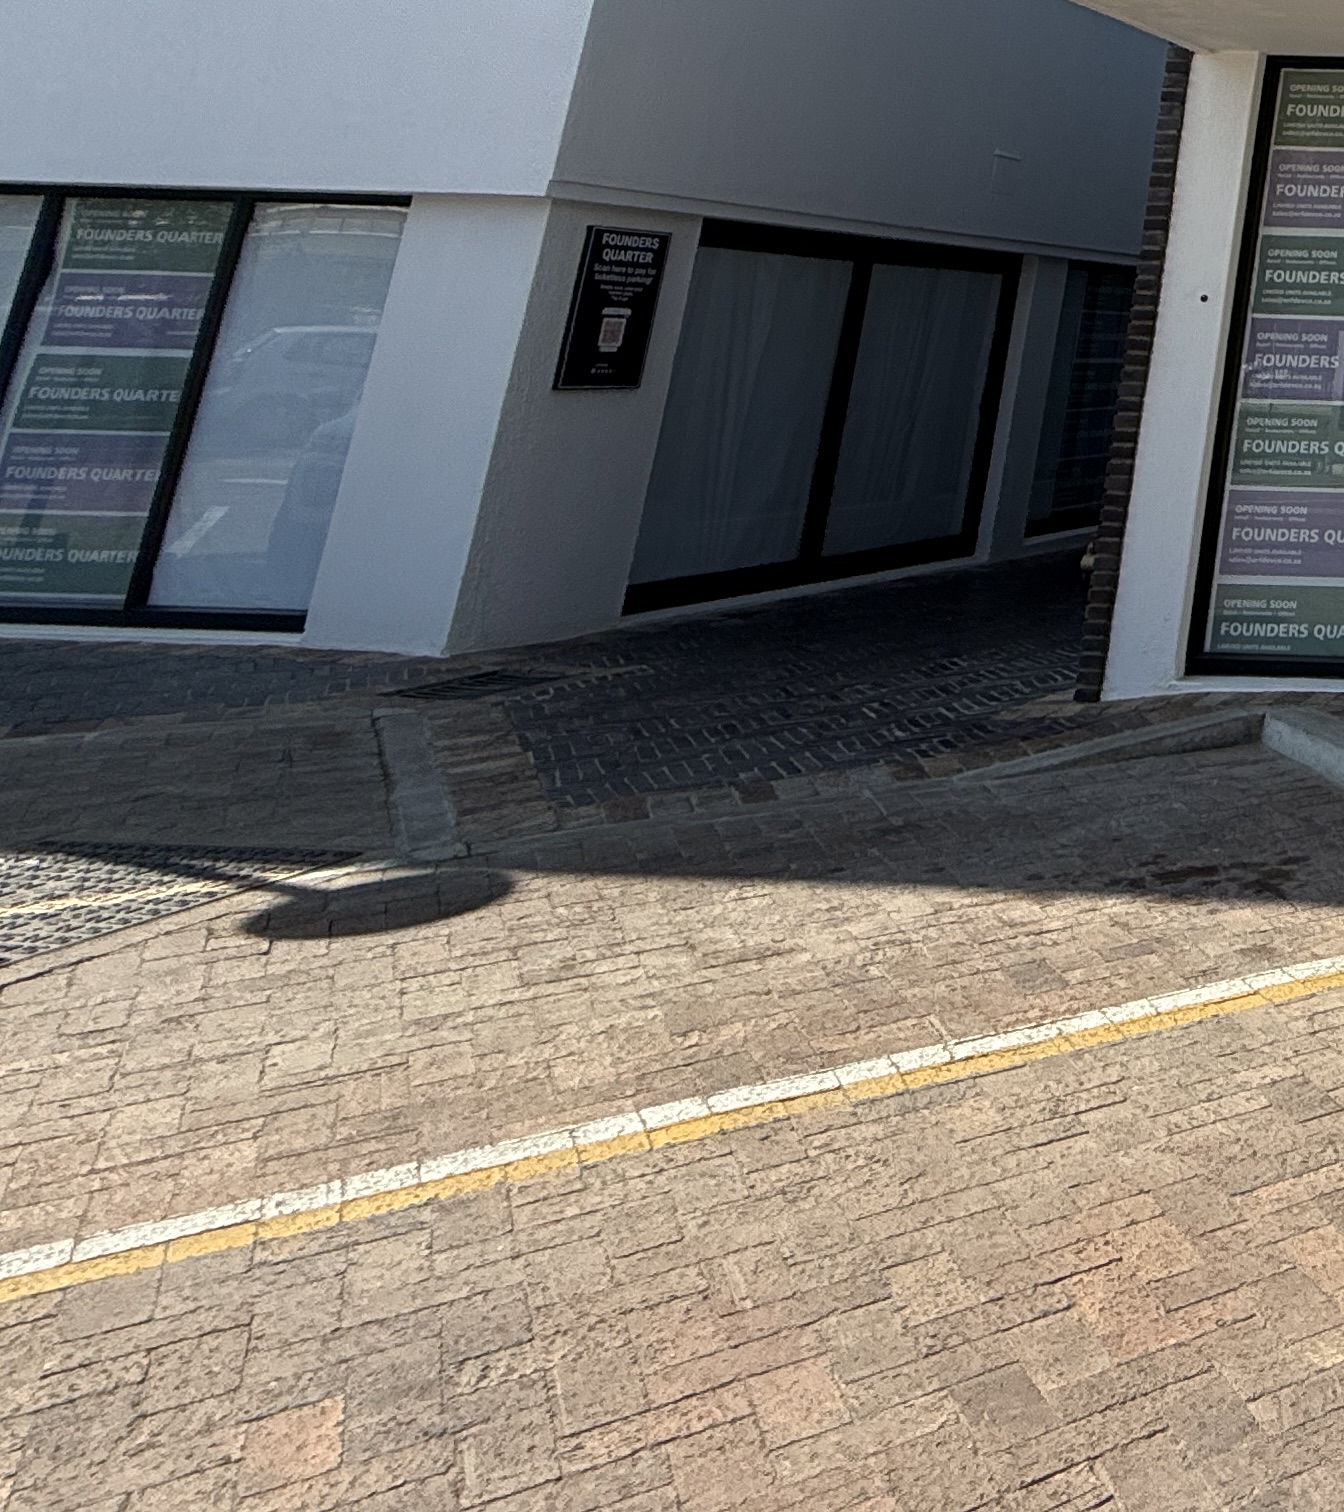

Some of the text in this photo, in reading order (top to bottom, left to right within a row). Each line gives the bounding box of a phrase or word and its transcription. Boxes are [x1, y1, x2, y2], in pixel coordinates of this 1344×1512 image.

[1289, 84, 1329, 93] OPENING
[1279, 163, 1319, 173] OPENING
[76, 228, 225, 244] FOUNDERS QUARTER
[602, 233, 660, 249] FOUNDERS
[602, 248, 654, 263] QUARTER
[1268, 249, 1338, 258] OPENING SOON
[58, 305, 133, 319] FOUNDERS
[1254, 353, 1339, 368] FOUNDERS
[28, 387, 181, 402] FOUNDERS QUARTE
[1246, 417, 1318, 427] OPENING SOON
[1243, 439, 1329, 454] FOUNDERS
[6, 466, 160, 482] FOUNDERS QUARTE
[1235, 504, 1307, 515] OPENING SOON
[1232, 527, 1319, 543] FOUNDERS
[0, 547, 64, 561] UNDERS
[1223, 599, 1298, 609] OPENING SOON
[1220, 622, 1309, 638] FOUNDERS
